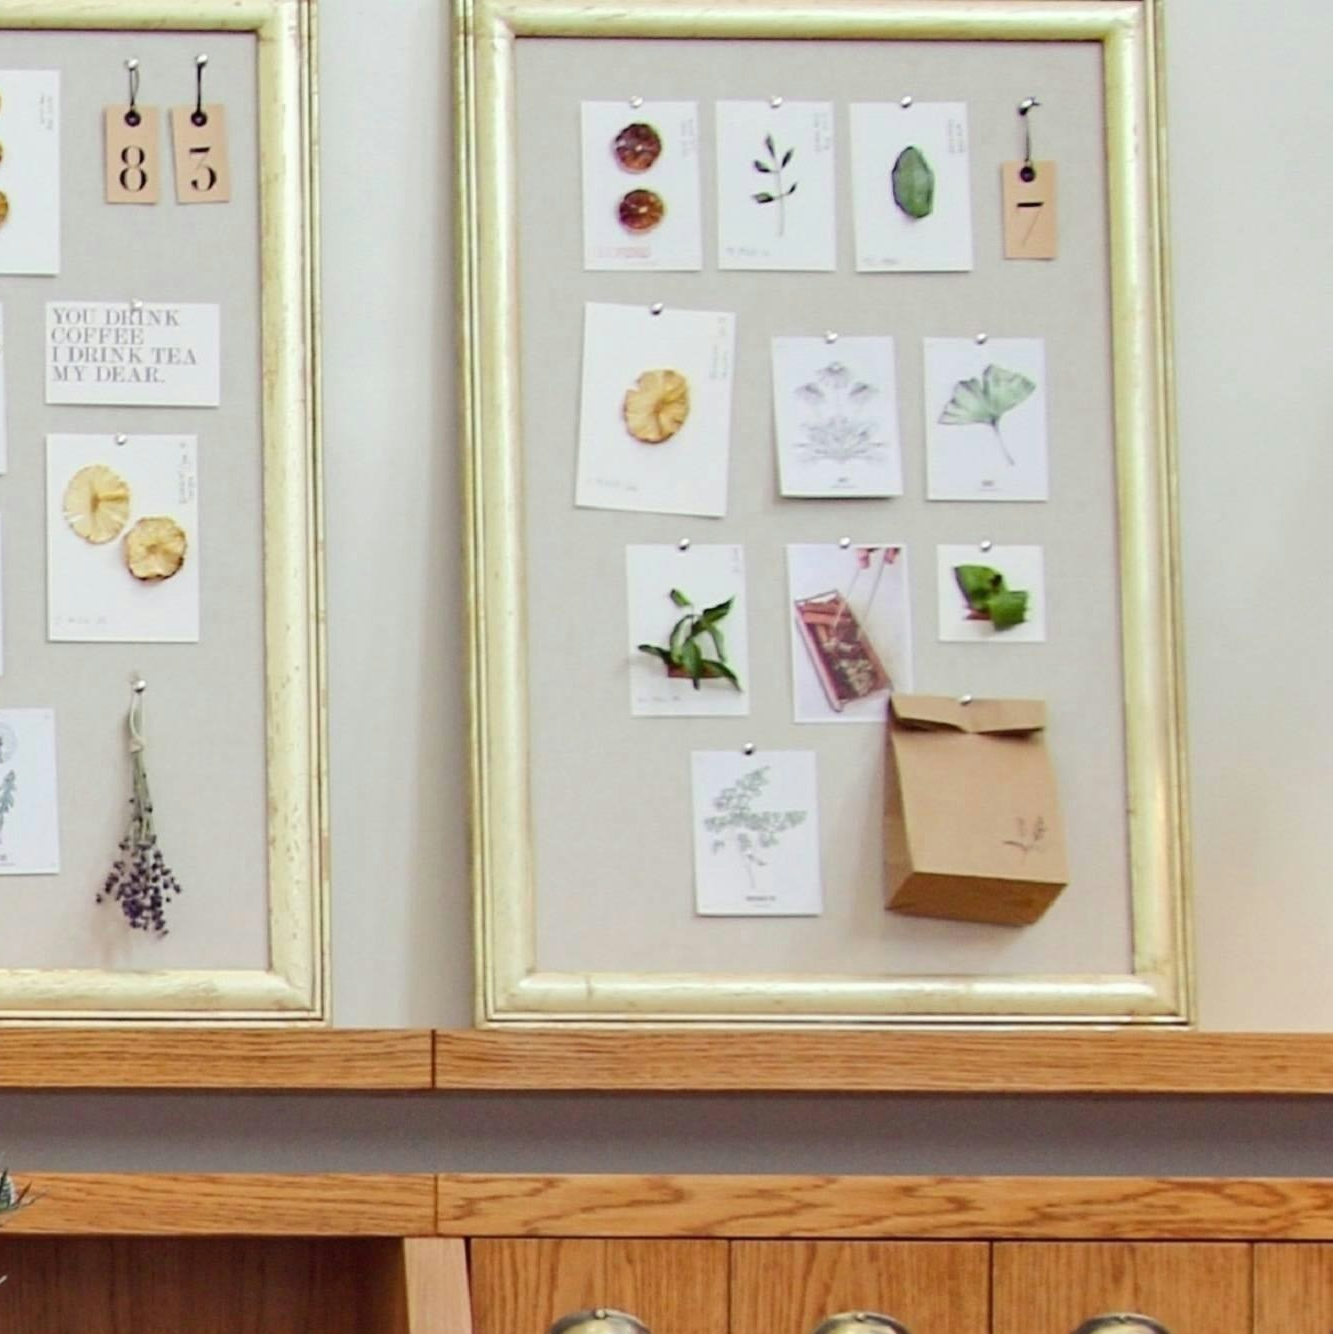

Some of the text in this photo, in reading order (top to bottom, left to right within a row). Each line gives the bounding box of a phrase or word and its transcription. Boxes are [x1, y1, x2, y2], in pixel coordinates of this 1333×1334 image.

[119, 145, 218, 193] 8 3
[1016, 200, 1045, 247] 7
[52, 307, 181, 327] YOU DRINK
[50, 327, 145, 345] COFFEE
[52, 346, 197, 366] I DRINK TEA
[51, 365, 166, 384] MY DEAR.
